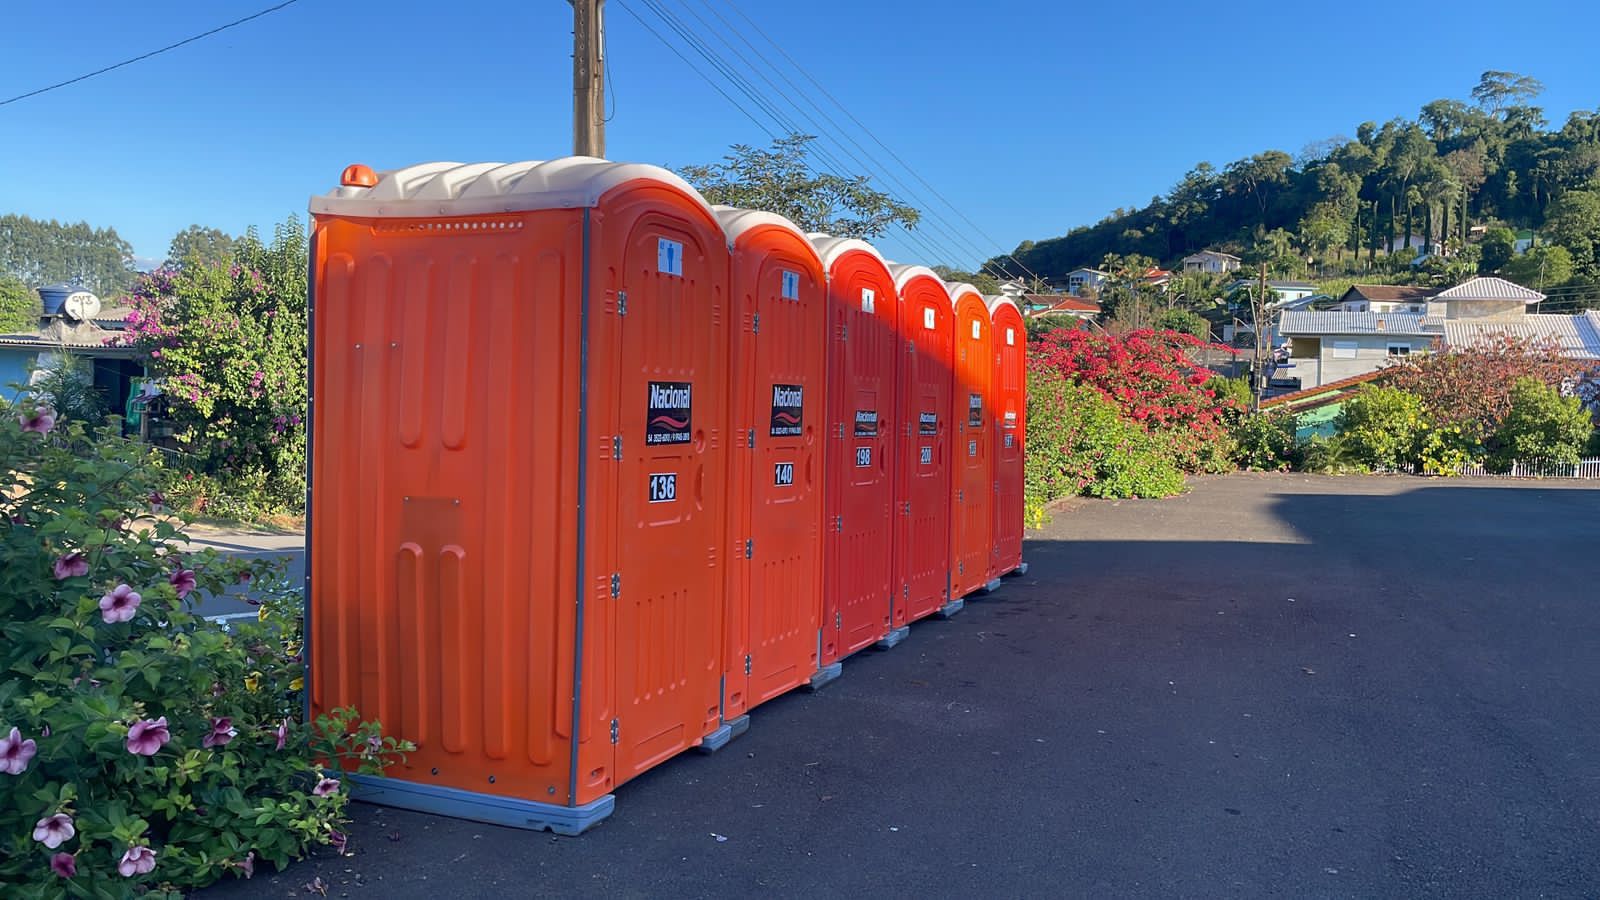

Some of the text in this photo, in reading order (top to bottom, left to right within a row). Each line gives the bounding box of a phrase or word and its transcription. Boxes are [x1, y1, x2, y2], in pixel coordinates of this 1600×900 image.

[650, 384, 690, 409] Nacional
[773, 386, 802, 407] Nacional
[857, 448, 870, 465] 198
[776, 465, 792, 483] 140
[651, 476, 675, 499] 136
